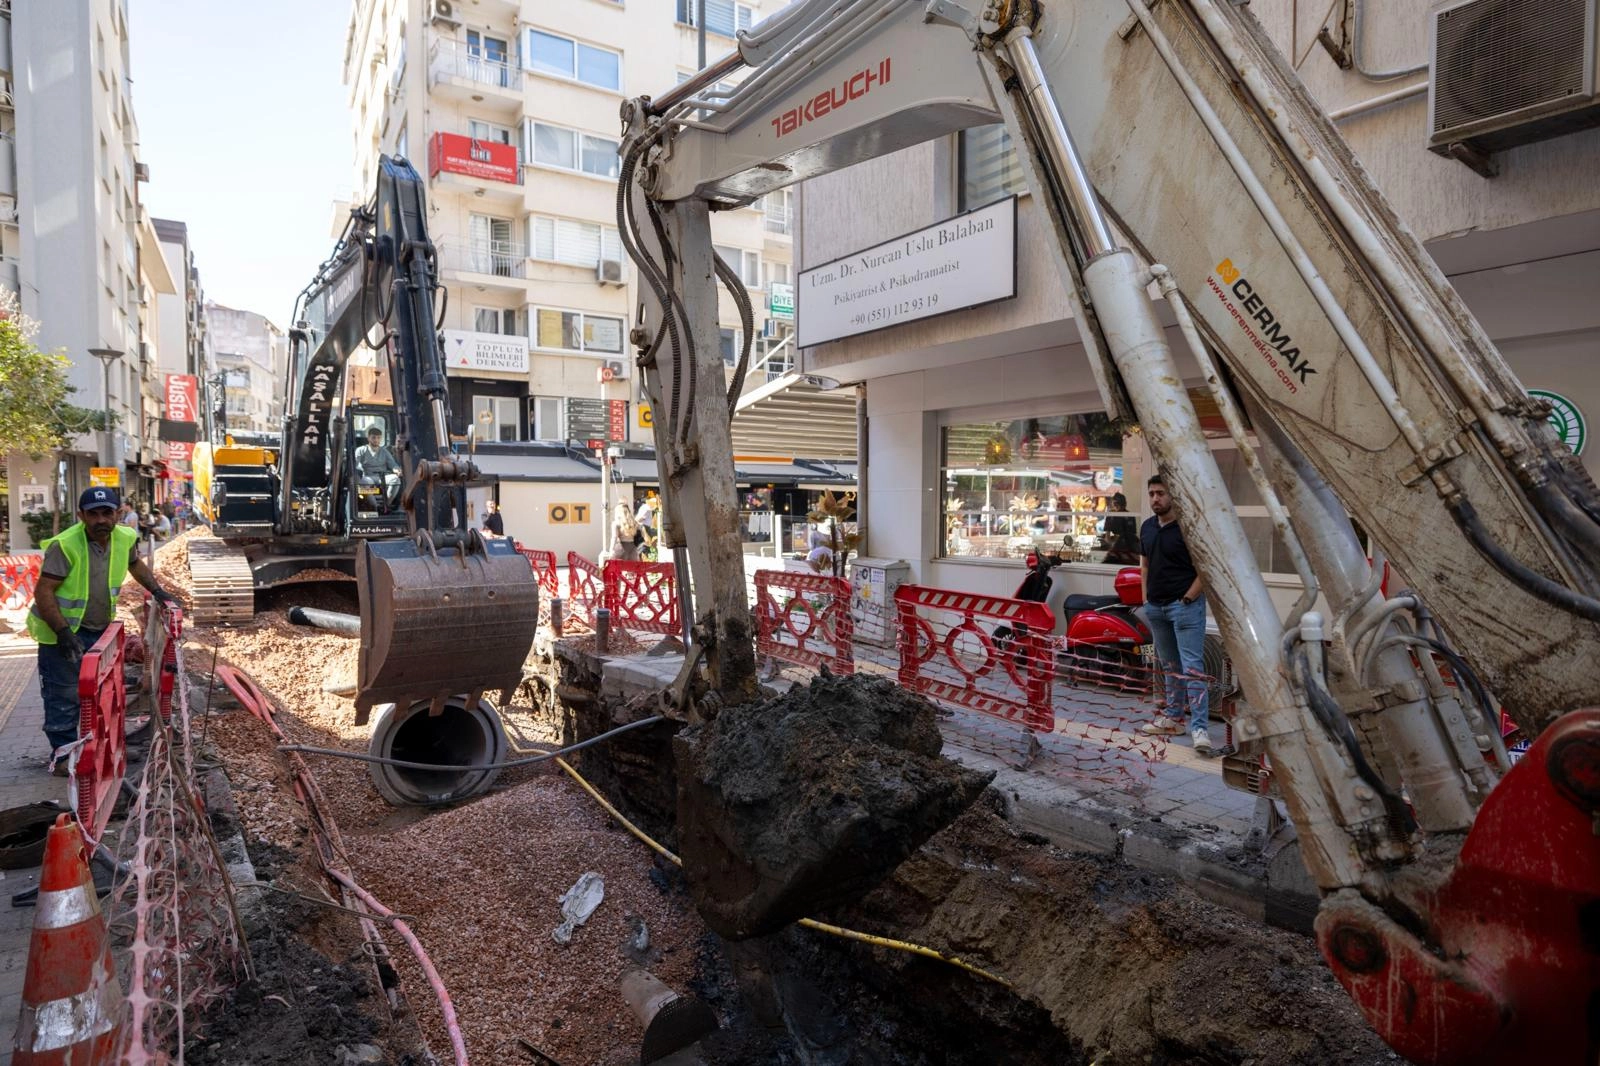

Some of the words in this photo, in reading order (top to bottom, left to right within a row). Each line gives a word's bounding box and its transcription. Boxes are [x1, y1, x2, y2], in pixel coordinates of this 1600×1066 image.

[811, 272, 837, 288] Uzm.
[840, 264, 857, 278] Dr.
[861, 249, 902, 272] Nurcan
[906, 237, 934, 257] Uslu
[939, 217, 994, 246] Balaban
[834, 283, 879, 305] Psikiyatrist
[879, 282, 887, 293] &
[889, 260, 961, 290] Psikodramatist
[867, 305, 891, 324] (551)
[894, 301, 909, 316] 112
[912, 298, 924, 311] 93
[927, 294, 939, 307] 19
[476, 344, 524, 353] TOPLUM
[1232, 278, 1318, 384] CERMAK
[551, 506, 587, 522] OT
